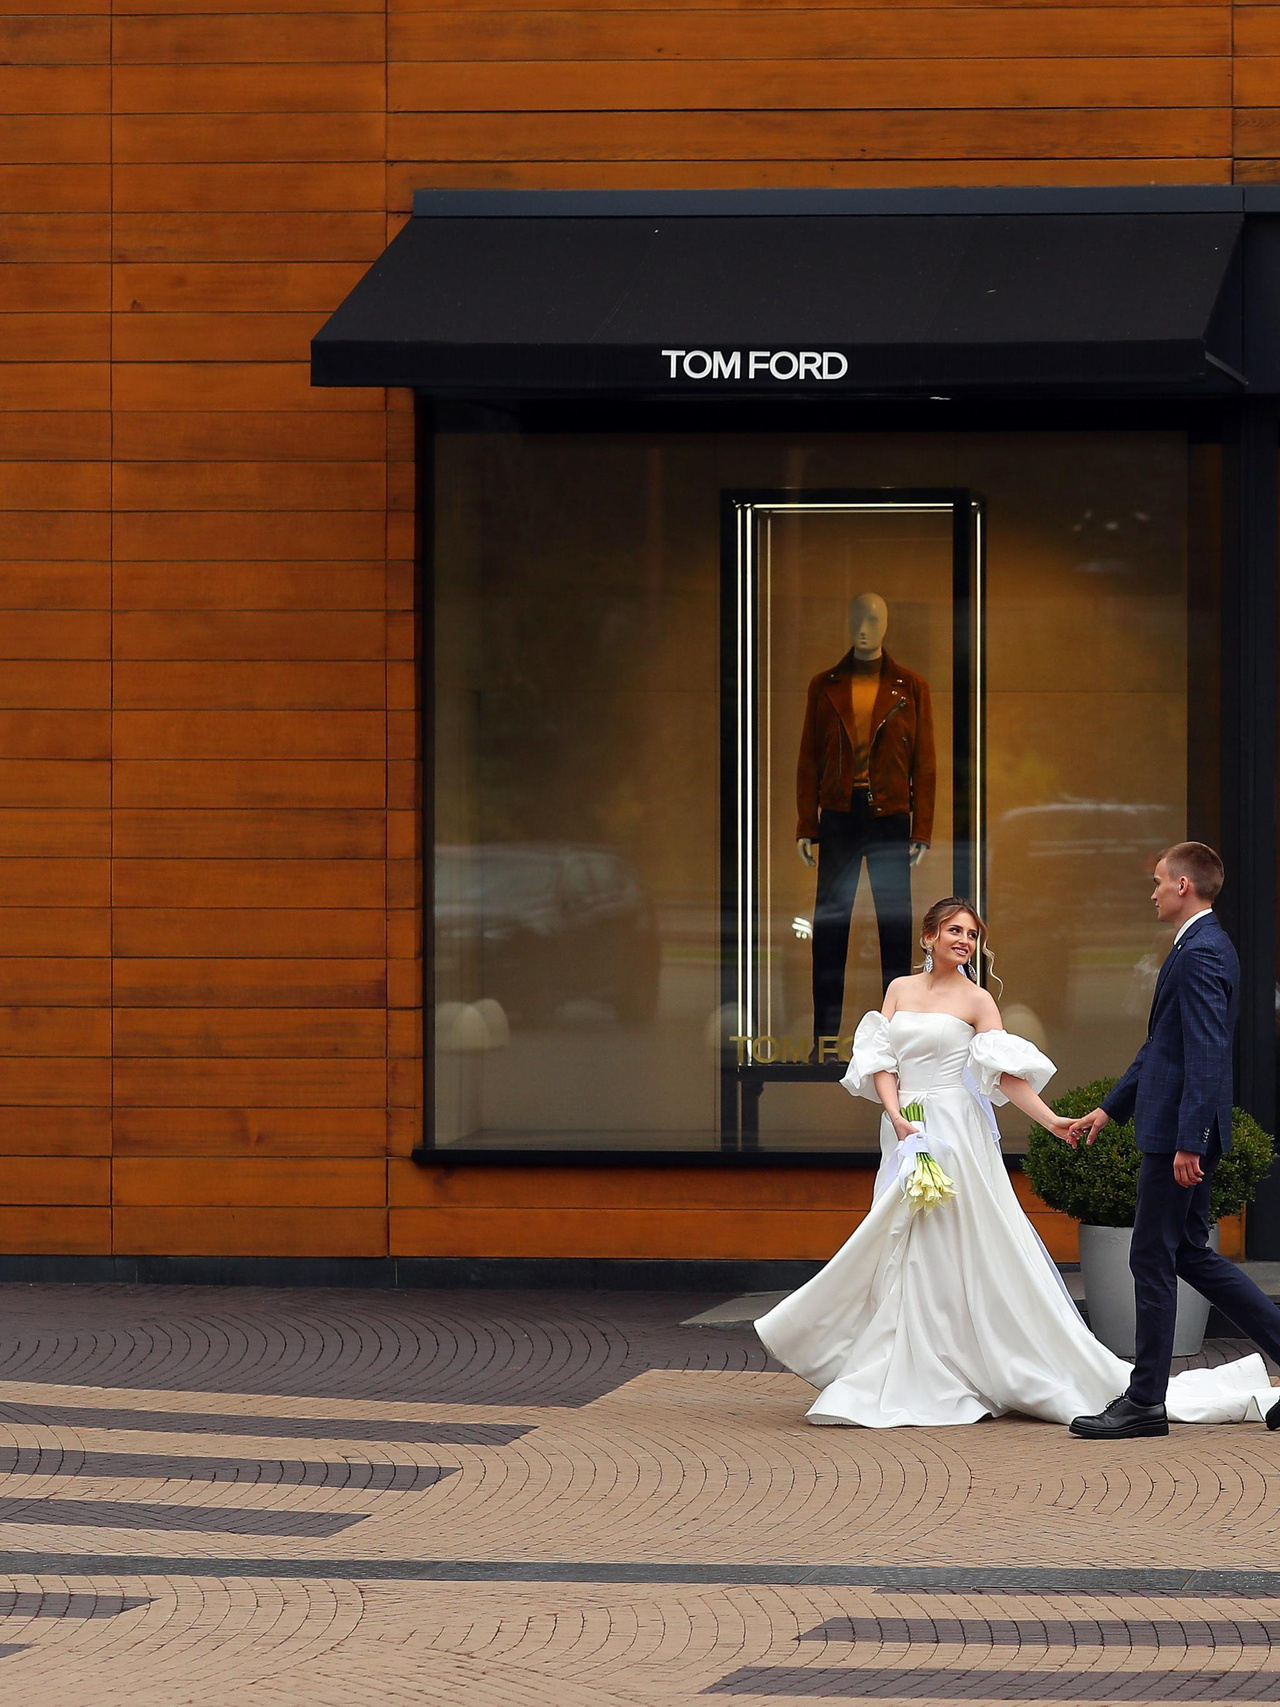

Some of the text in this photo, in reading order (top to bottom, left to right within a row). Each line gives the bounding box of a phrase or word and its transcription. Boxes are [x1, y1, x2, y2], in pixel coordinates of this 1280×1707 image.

[661, 350, 849, 380] TOM FORD
[728, 1035, 810, 1064] TOM
